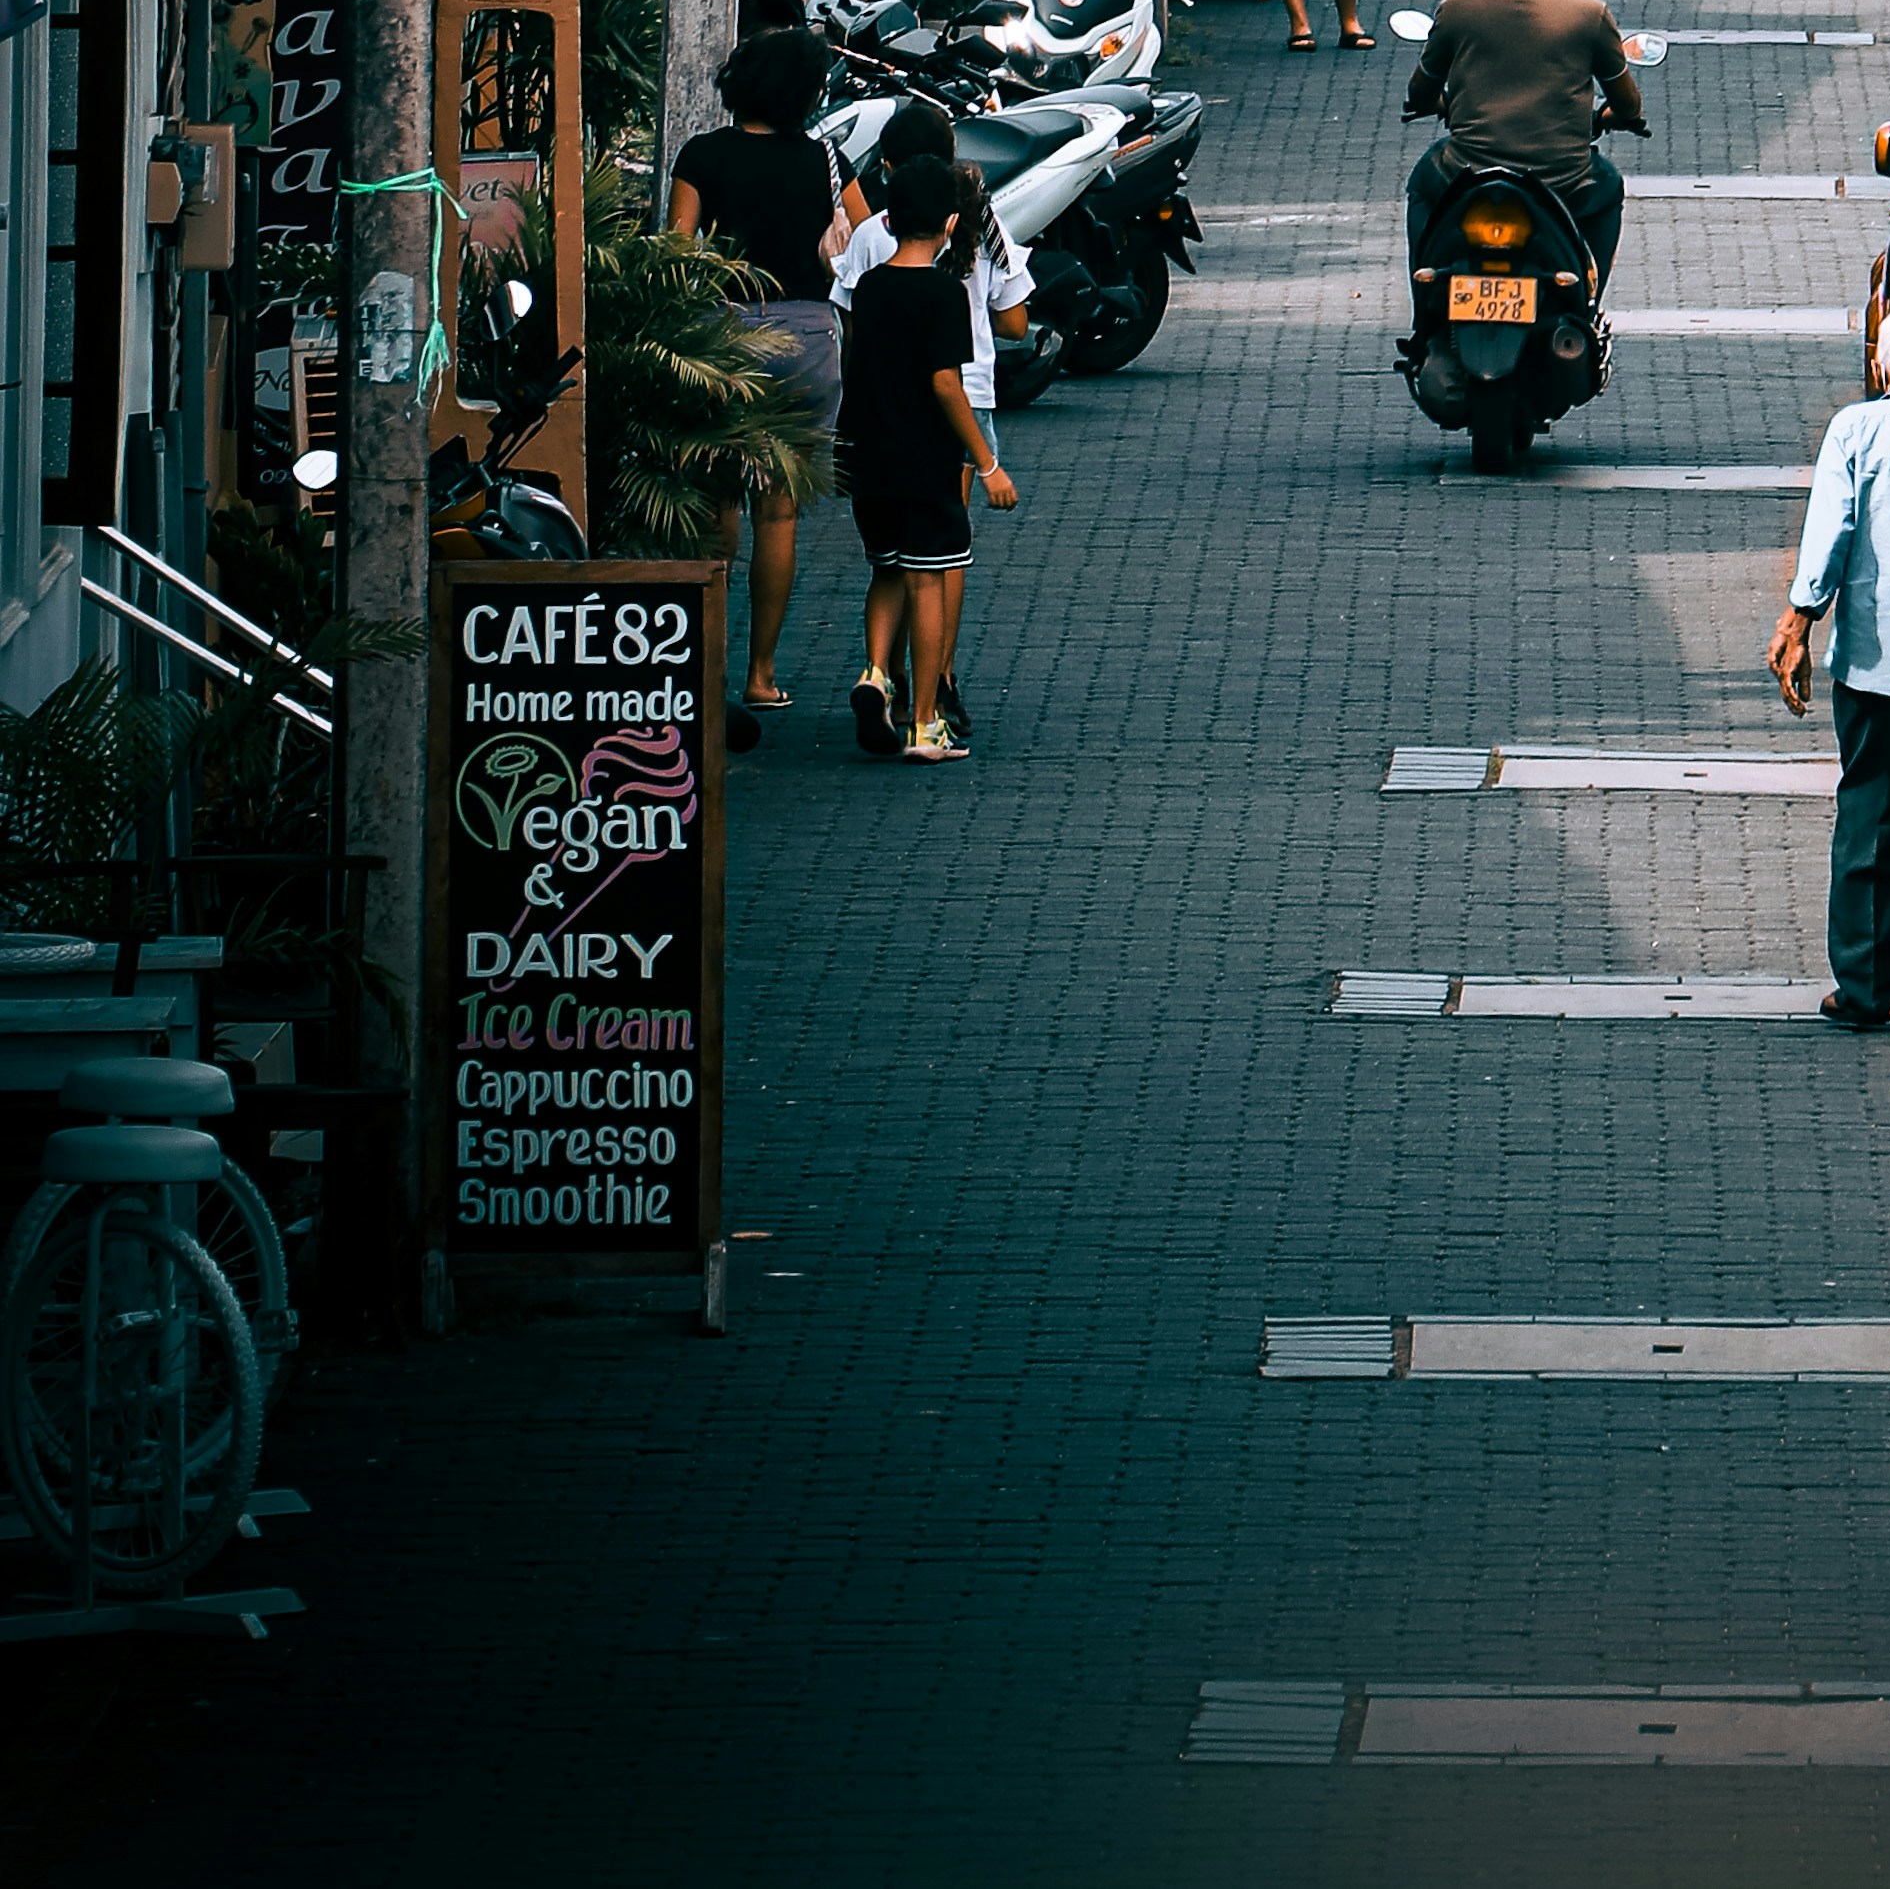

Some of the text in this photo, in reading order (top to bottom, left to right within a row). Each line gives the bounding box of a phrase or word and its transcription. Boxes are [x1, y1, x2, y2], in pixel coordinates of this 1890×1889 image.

[1480, 280, 1521, 299] BFJ
[466, 676, 694, 722] Home made
[524, 863, 564, 909] &
[466, 932, 673, 979] DAIRY
[457, 991, 695, 1051] Ice Cream
[456, 1060, 693, 1116] Cappuccino
[457, 1120, 676, 1174] Espresso
[458, 1172, 671, 1225] Smoothie
